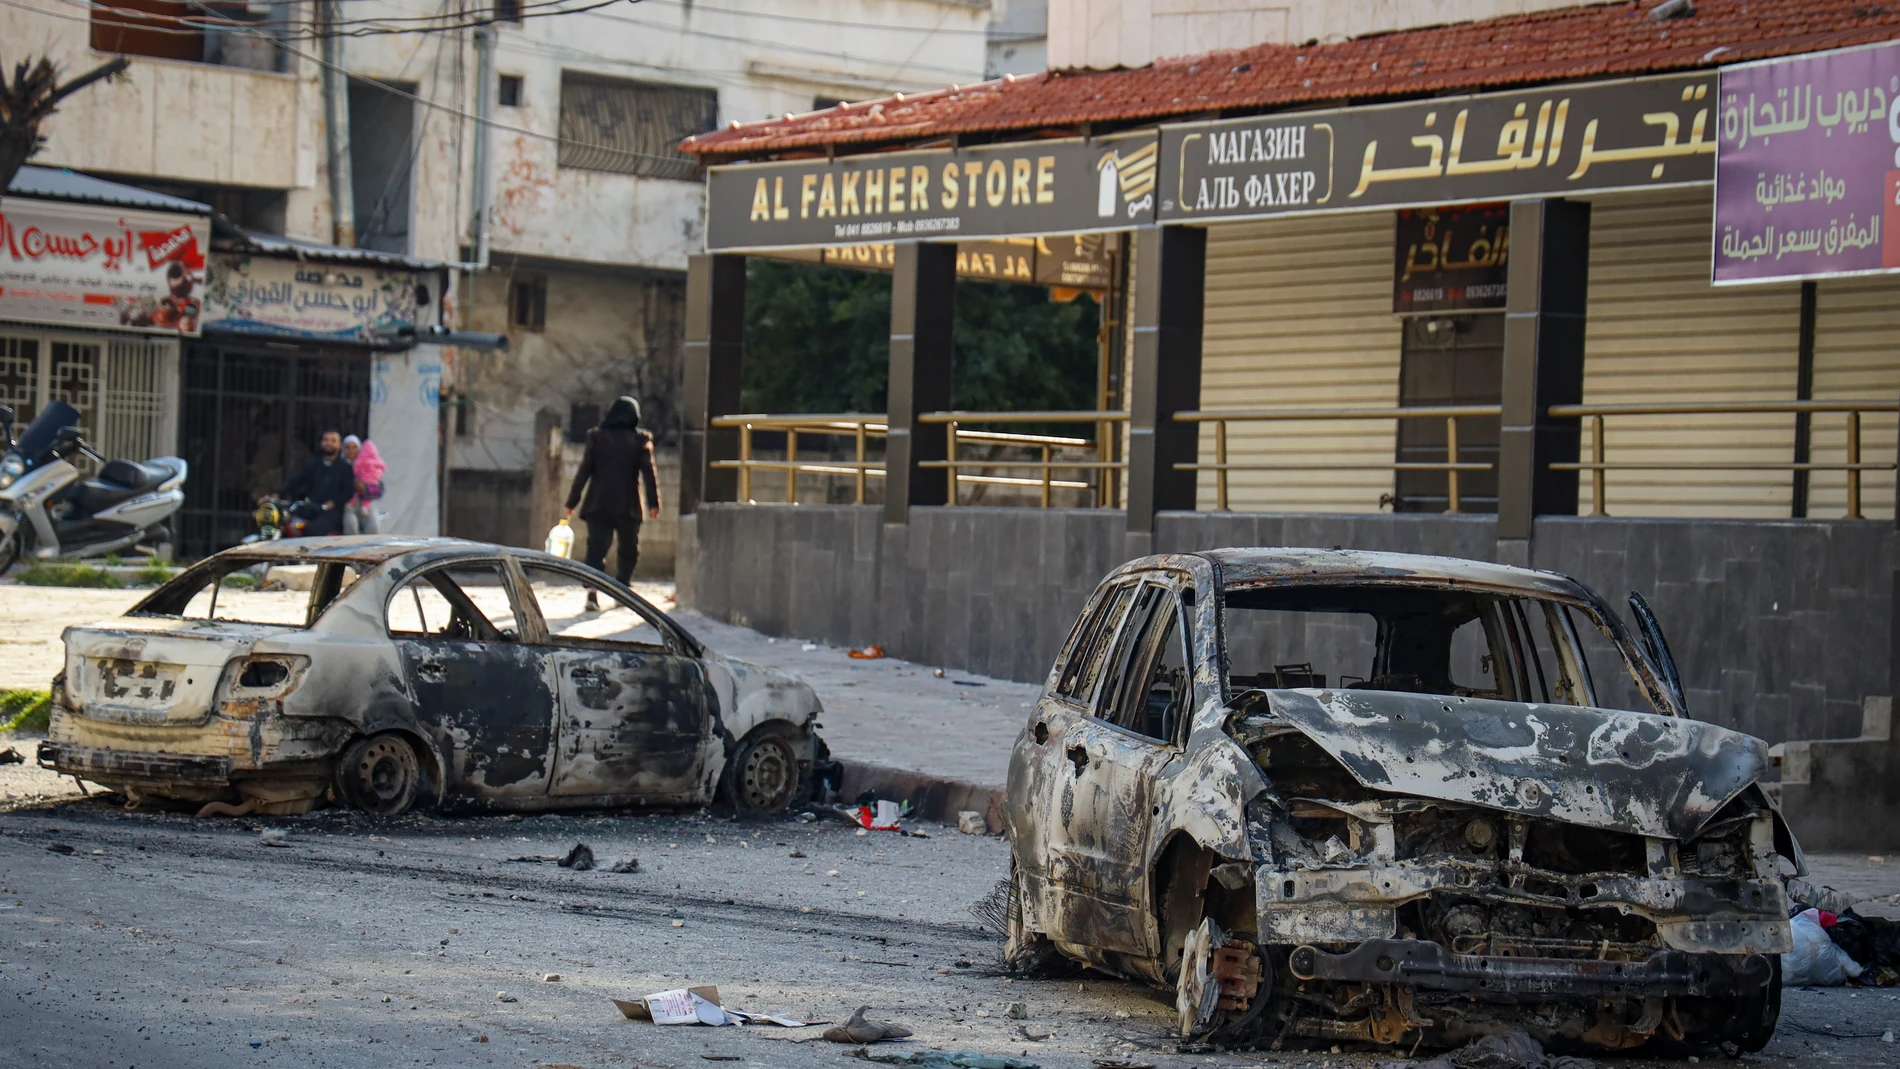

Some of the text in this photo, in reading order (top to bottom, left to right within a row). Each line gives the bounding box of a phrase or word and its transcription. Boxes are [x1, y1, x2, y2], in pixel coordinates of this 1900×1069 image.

[1724, 84, 1811, 149] للتجارة
[1816, 85, 1886, 137] ديوب
[1208, 125, 1306, 165] МАГАЗИН
[1349, 84, 1718, 197] تجر الفاخر
[750, 155, 1056, 222] AL FAKHER STORE
[1195, 170, 1316, 210] АЛЬ ФАХЕР
[1756, 170, 1846, 212] مواد غذائية
[22, 225, 100, 257] حسن
[103, 217, 133, 270] أبو
[1722, 213, 1880, 262] المفرق بسعر الجملة
[293, 290, 349, 312] حسن
